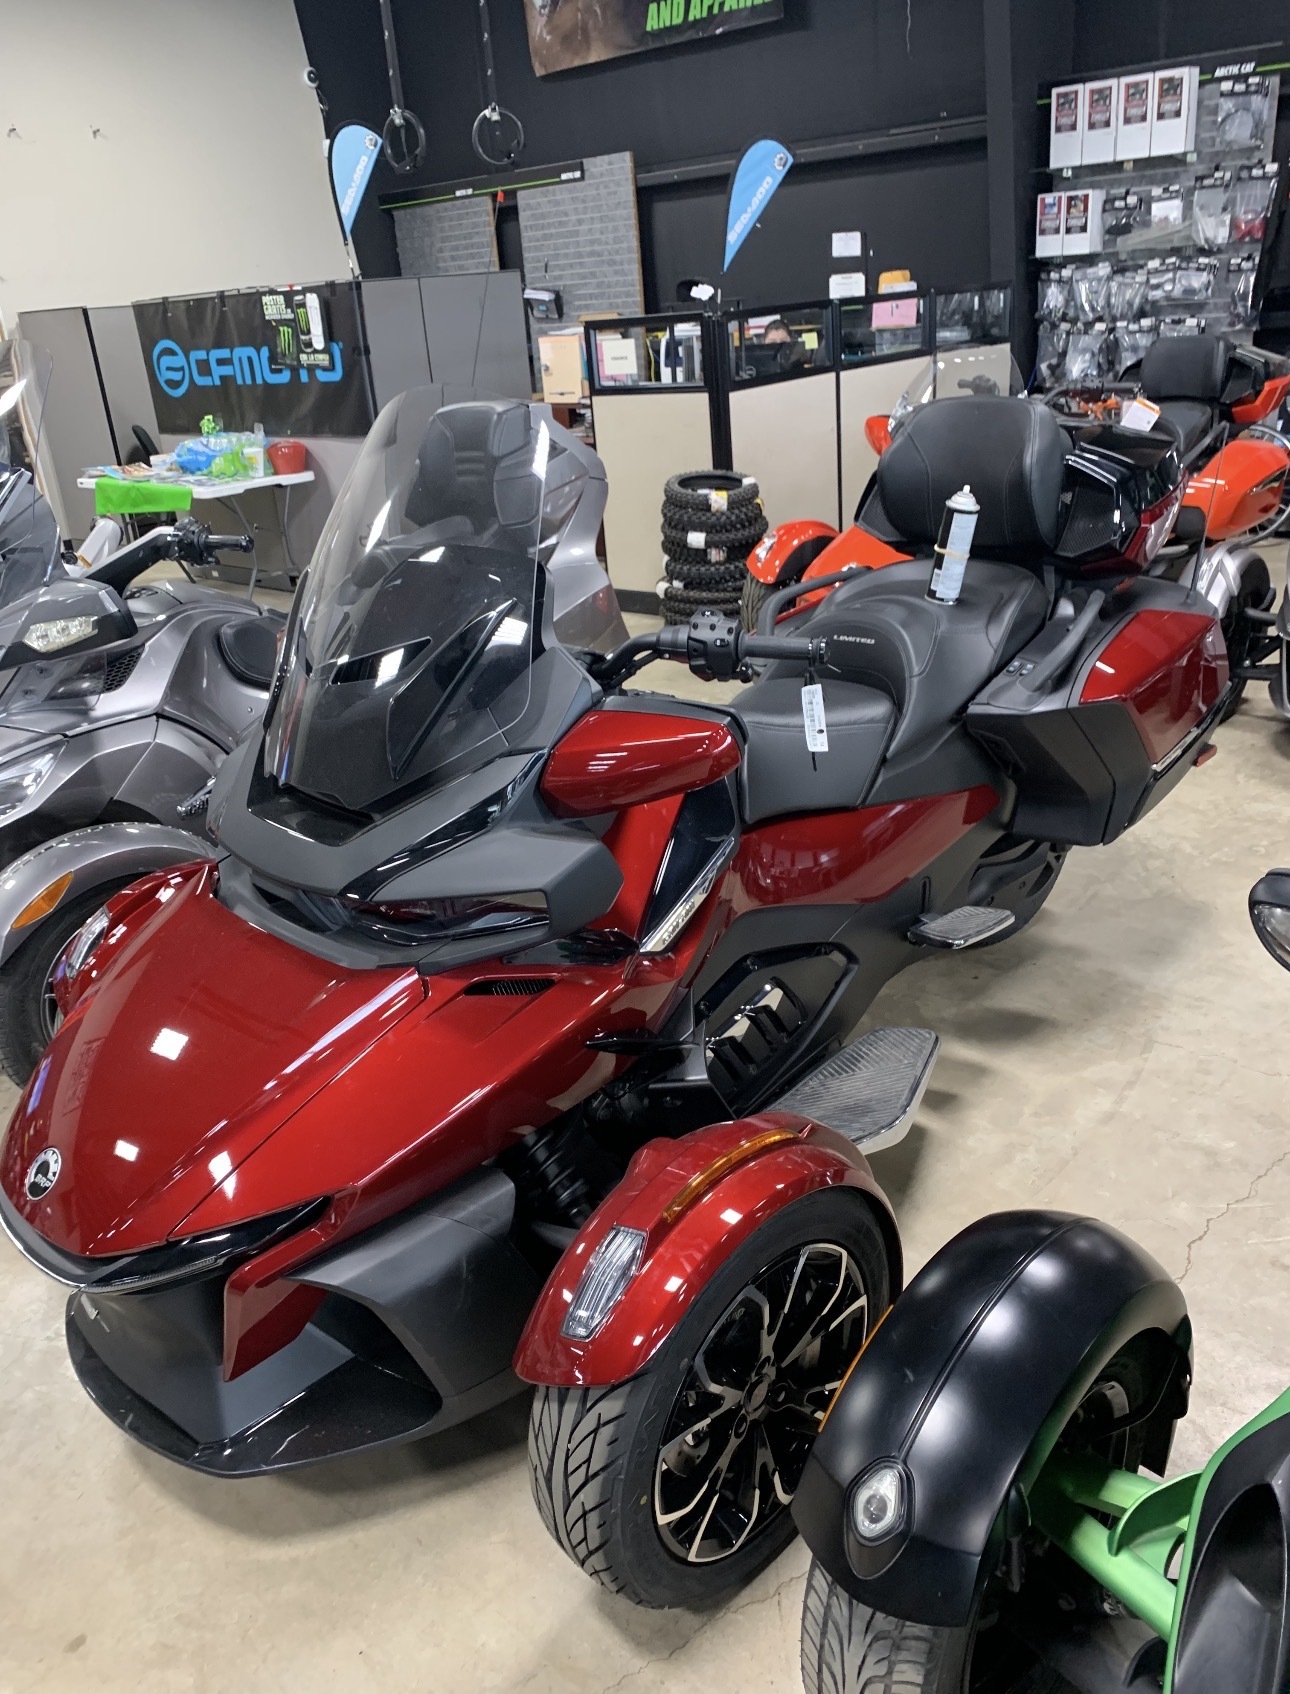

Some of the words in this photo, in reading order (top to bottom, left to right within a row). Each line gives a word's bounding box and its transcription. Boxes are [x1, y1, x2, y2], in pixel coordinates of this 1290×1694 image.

[646, 0, 685, 31] AND
[1214, 64, 1240, 77] ARCTIC
[1241, 61, 1256, 74] CAT
[189, 343, 343, 386] CFMOO
[833, 635, 875, 645] LIMITED
[35, 1173, 52, 1187] BRP
